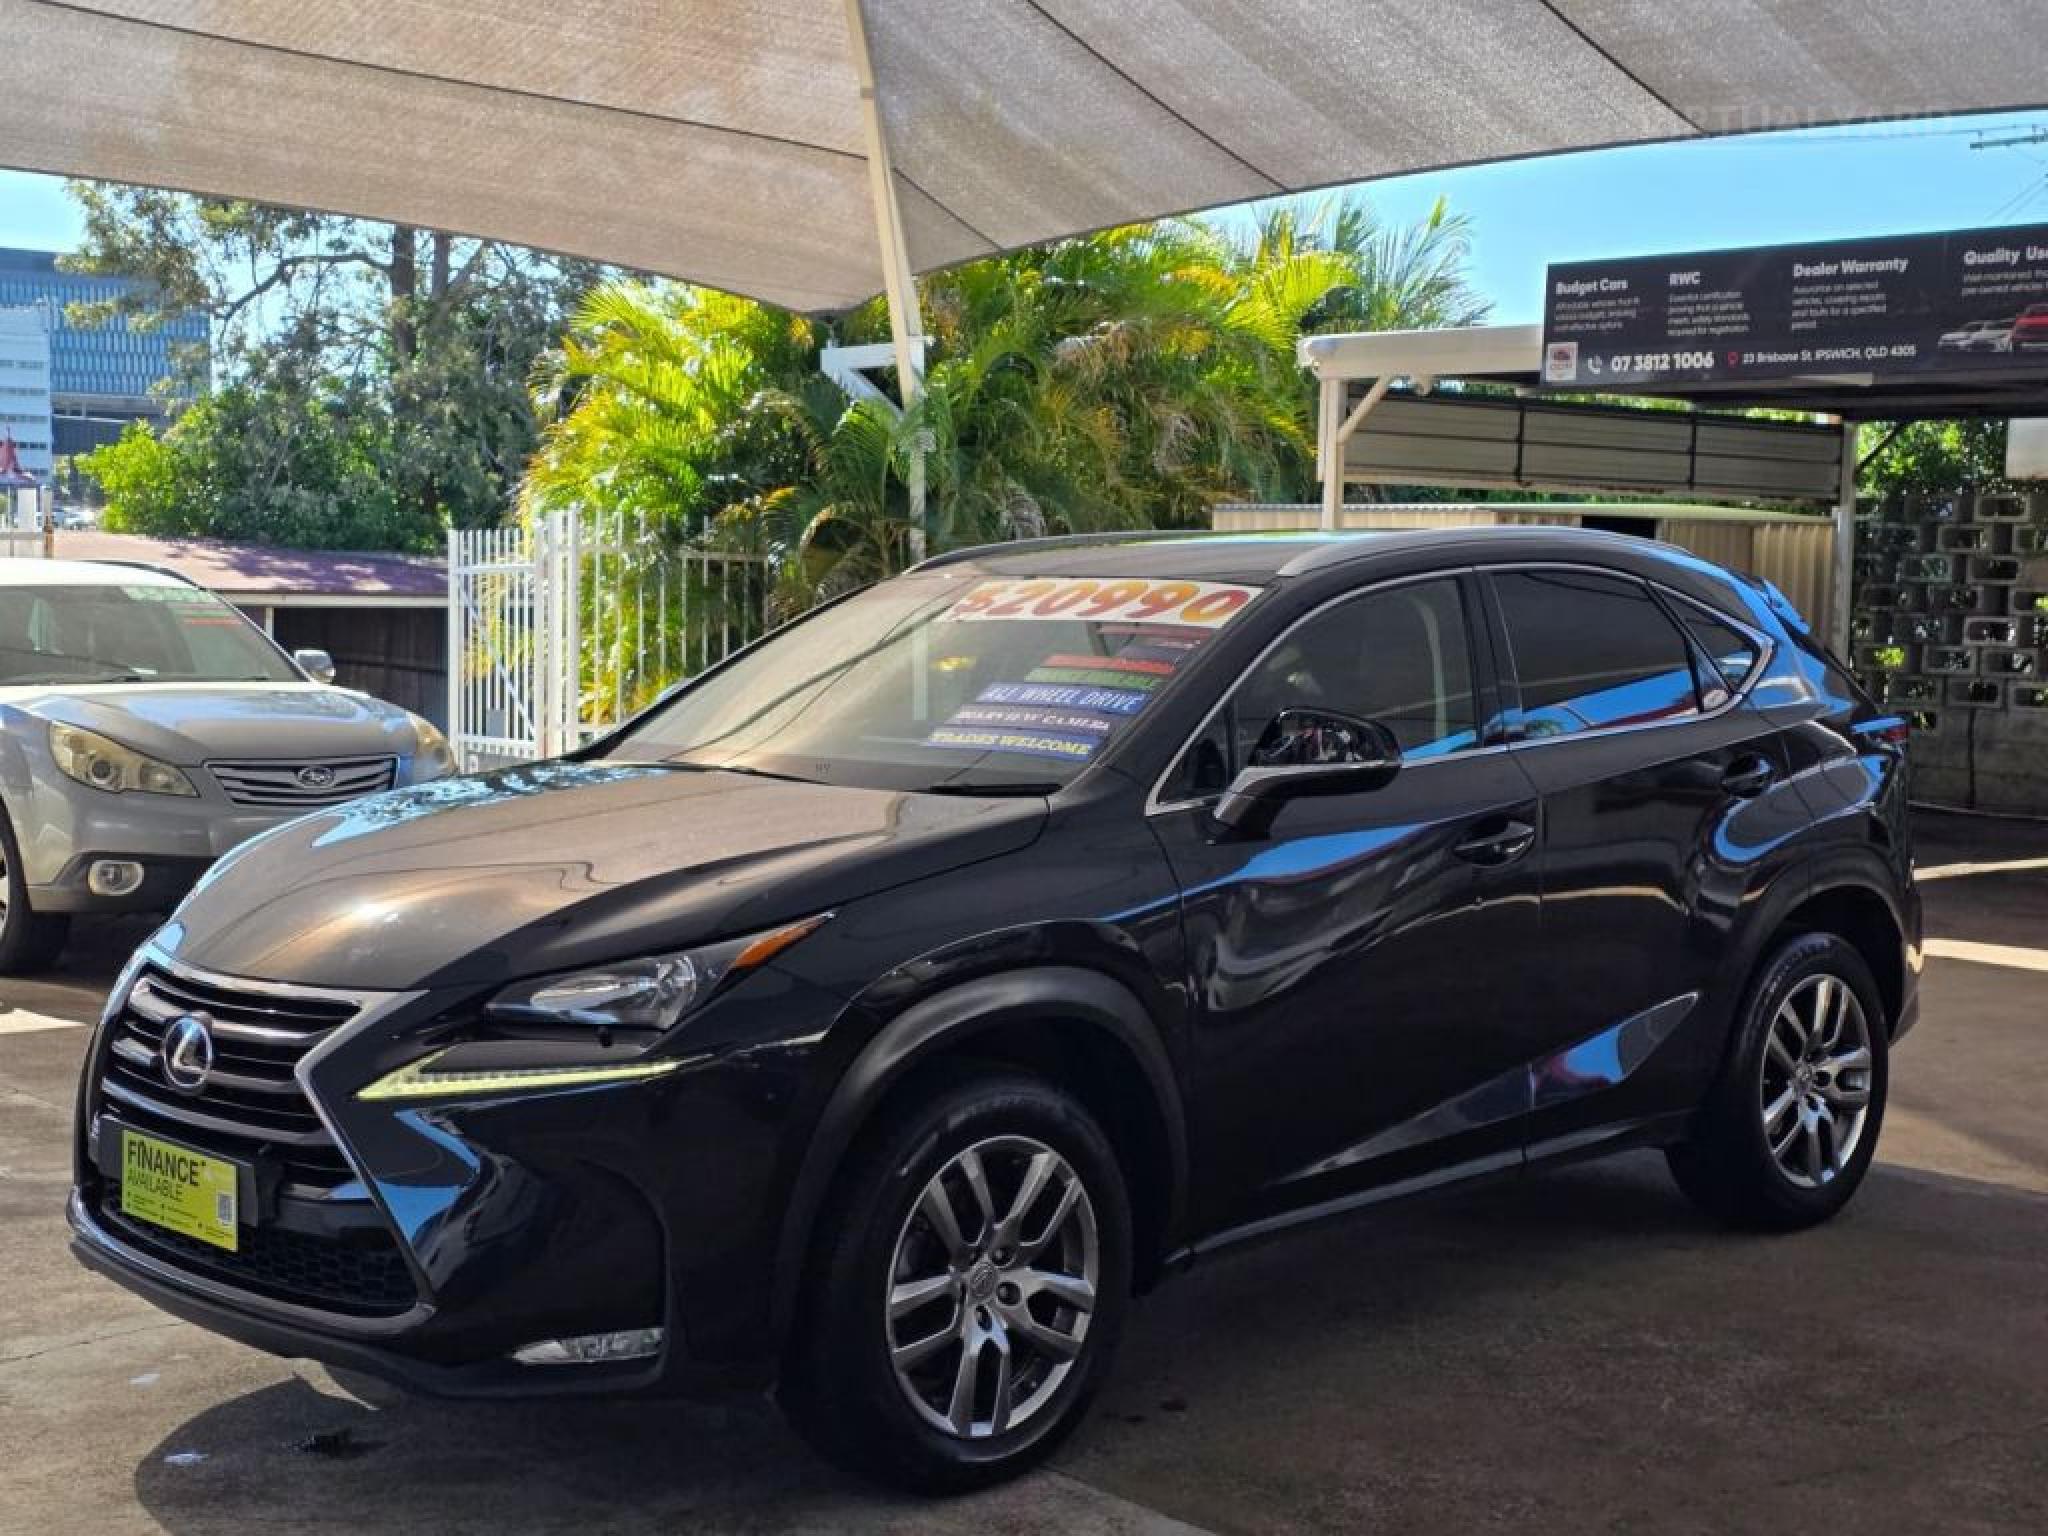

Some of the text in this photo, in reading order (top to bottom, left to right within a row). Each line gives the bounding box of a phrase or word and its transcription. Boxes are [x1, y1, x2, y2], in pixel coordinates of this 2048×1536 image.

[1963, 247, 2020, 265] Quality
[1793, 258, 1909, 278] Dealer Warranty
[1555, 277, 1629, 297] Budget Cars
[1669, 271, 1701, 287] RWC
[1611, 351, 1715, 372] 07 3812 1006
[1757, 352, 1799, 363] Brisbane
[1865, 345, 1889, 360] QLD
[1890, 344, 1917, 357] 4305
[953, 580, 1250, 622] $20990
[1020, 687, 1080, 704] WHEEL
[1080, 690, 1146, 711] DRIVE
[996, 735, 1091, 754] WELCOME
[128, 1170, 183, 1200] AVAILABLE
